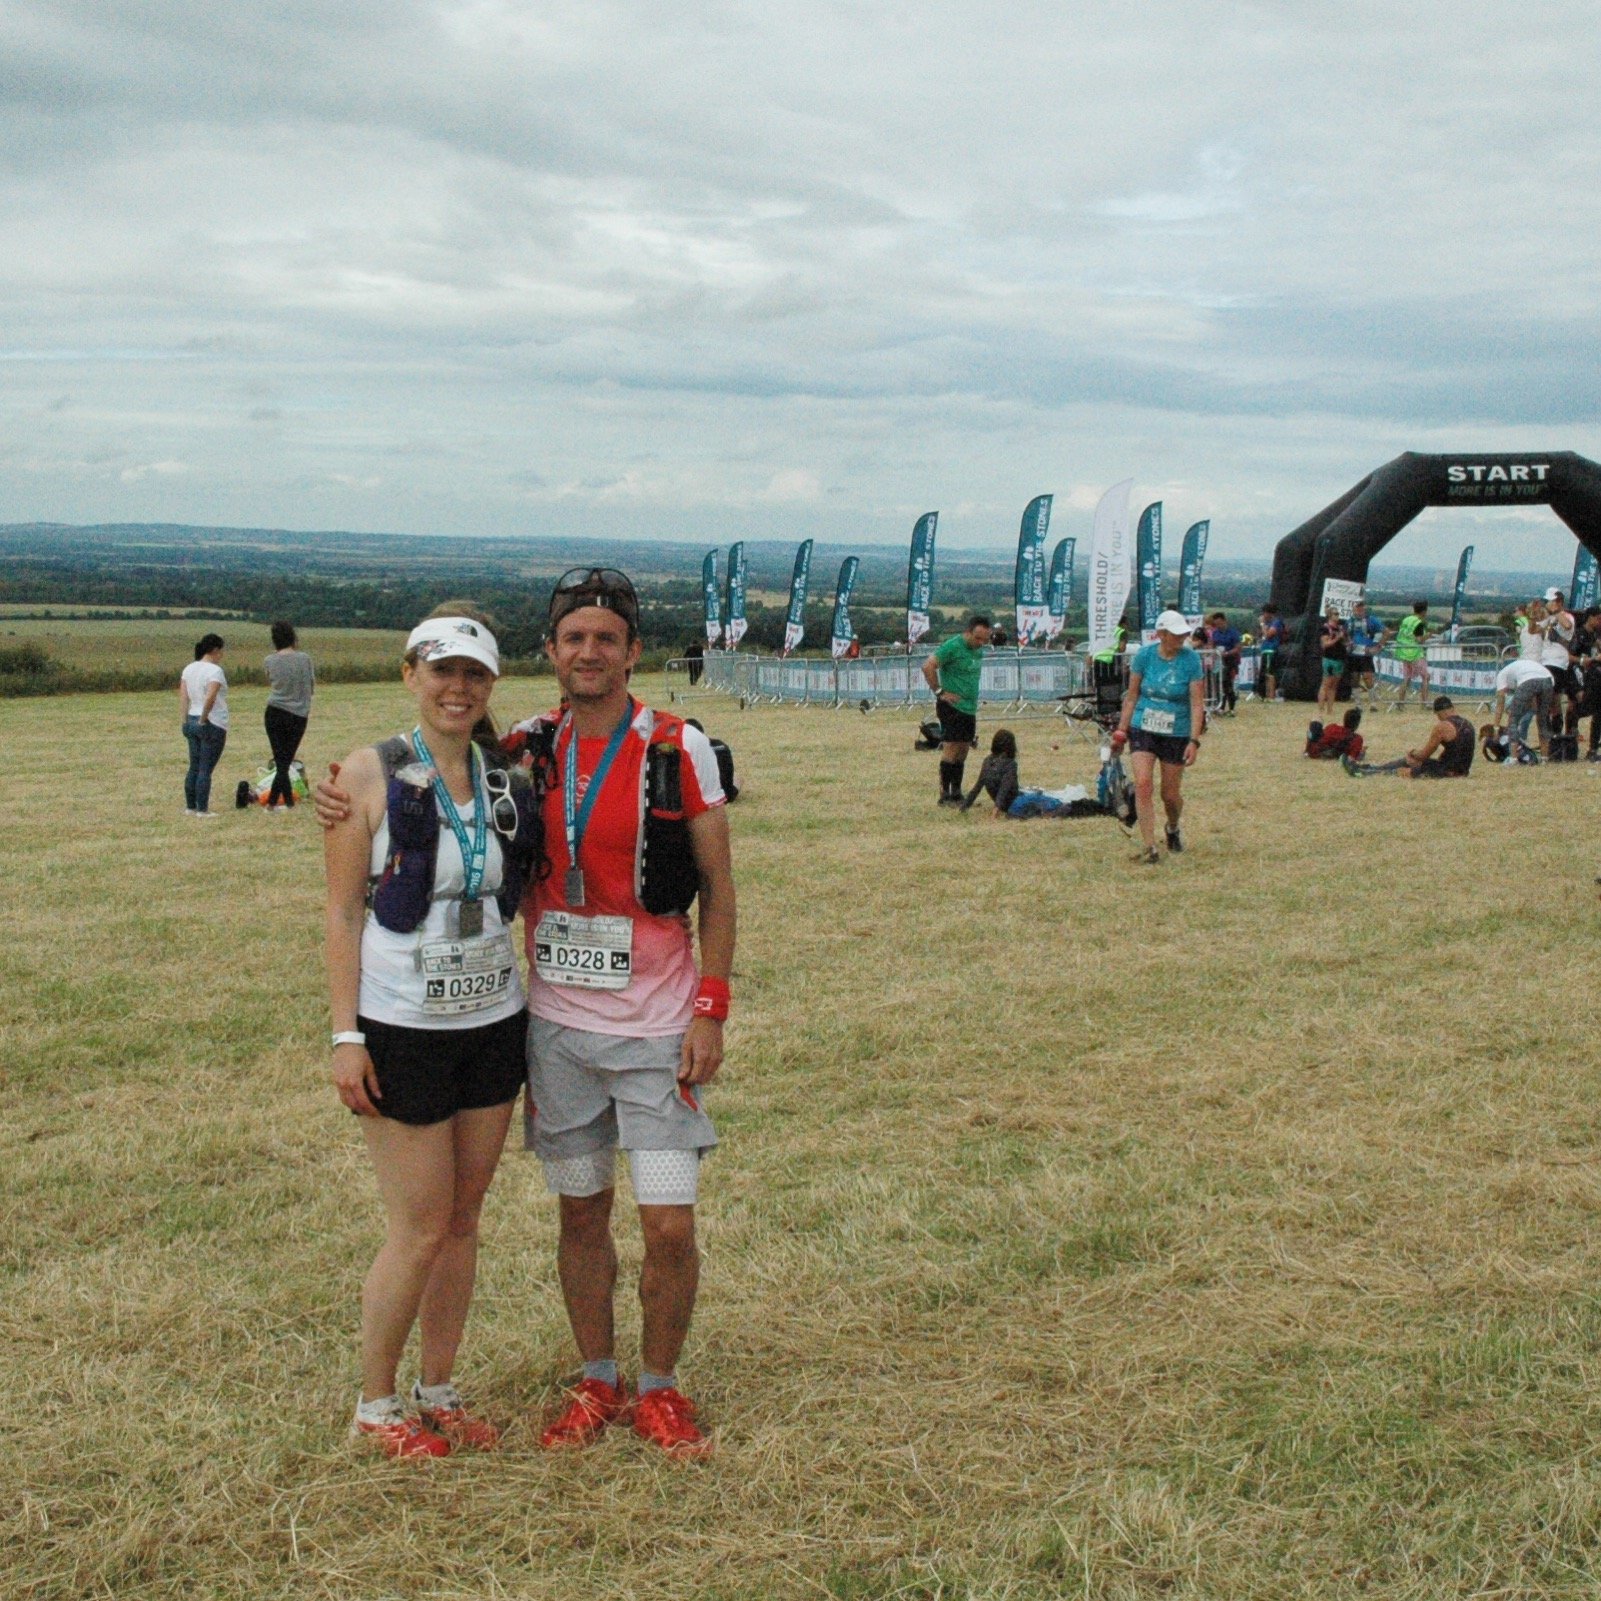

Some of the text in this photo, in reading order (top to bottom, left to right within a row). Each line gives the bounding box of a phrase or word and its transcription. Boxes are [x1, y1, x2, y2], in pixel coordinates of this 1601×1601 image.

[1447, 464, 1550, 482] START
[1036, 498, 1048, 538] STONES
[1033, 560, 1042, 574] TO
[1032, 576, 1042, 602] RACE
[1324, 597, 1345, 608] RACE
[557, 947, 604, 970] 0328
[450, 974, 495, 997] 0329
